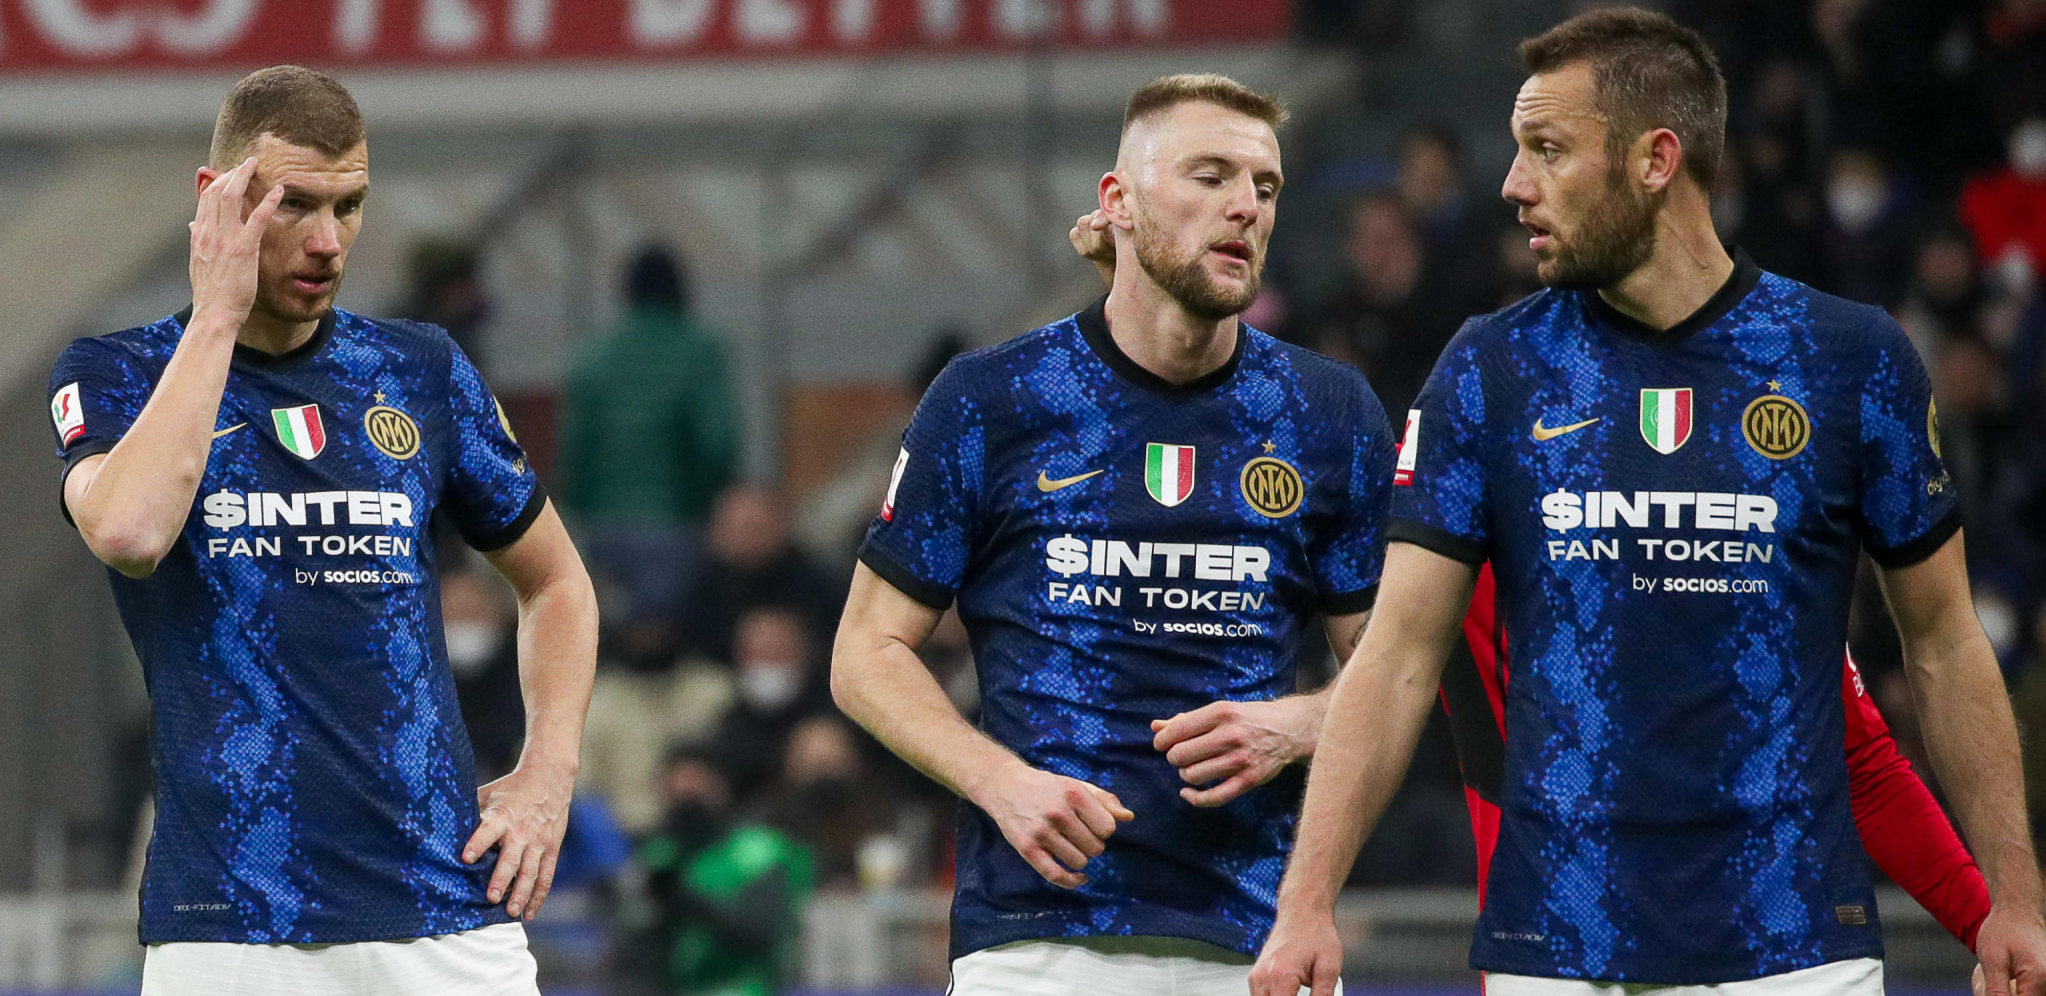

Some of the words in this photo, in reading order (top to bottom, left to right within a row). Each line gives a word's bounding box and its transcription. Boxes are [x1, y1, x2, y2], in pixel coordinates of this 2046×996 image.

[203, 488, 414, 532] $INTER
[1541, 487, 1778, 534] $INTER
[208, 536, 281, 558] FAN
[298, 535, 411, 557] TOKEN
[1046, 533, 1271, 582] $INTER
[1547, 538, 1619, 561] FAN
[1637, 539, 1773, 563] TOKEN
[295, 568, 319, 586] by
[1632, 572, 1657, 594] by
[1048, 581, 1121, 607] FAN
[1139, 587, 1265, 611] TOKEN
[1133, 618, 1156, 635] by
